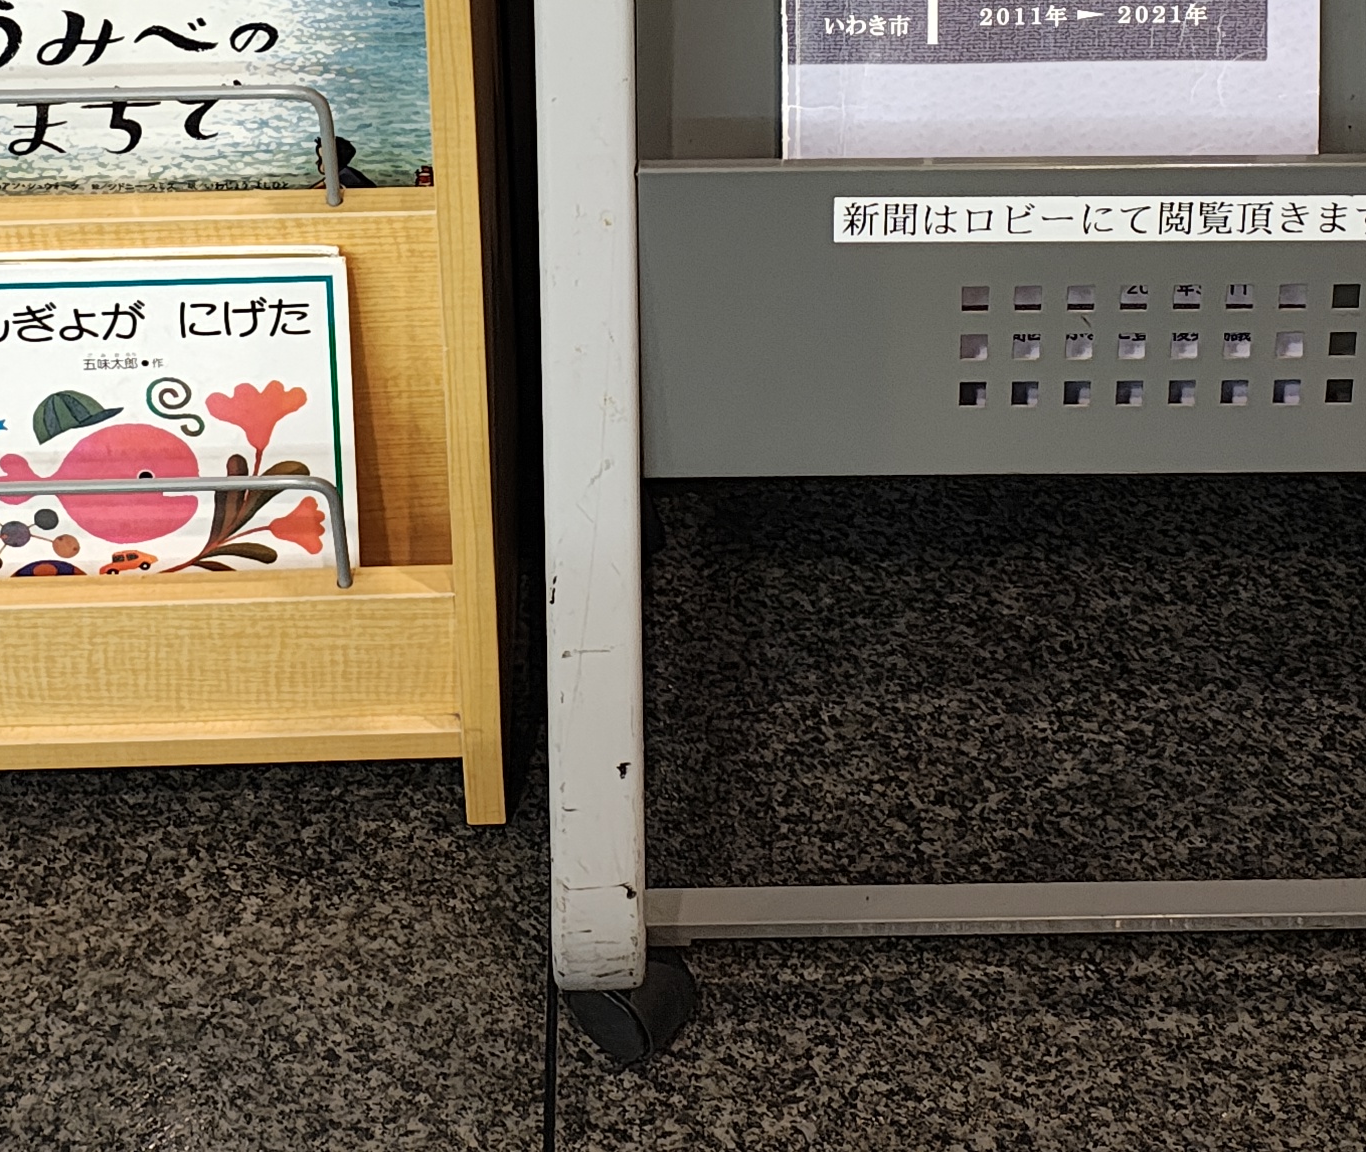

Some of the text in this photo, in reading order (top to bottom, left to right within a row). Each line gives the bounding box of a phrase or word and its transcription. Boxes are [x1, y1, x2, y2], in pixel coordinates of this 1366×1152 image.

[823, 14, 912, 38] いわき市
[979, 2, 1209, 29] 2011年 2021年
[180, 297, 312, 339] にげた
